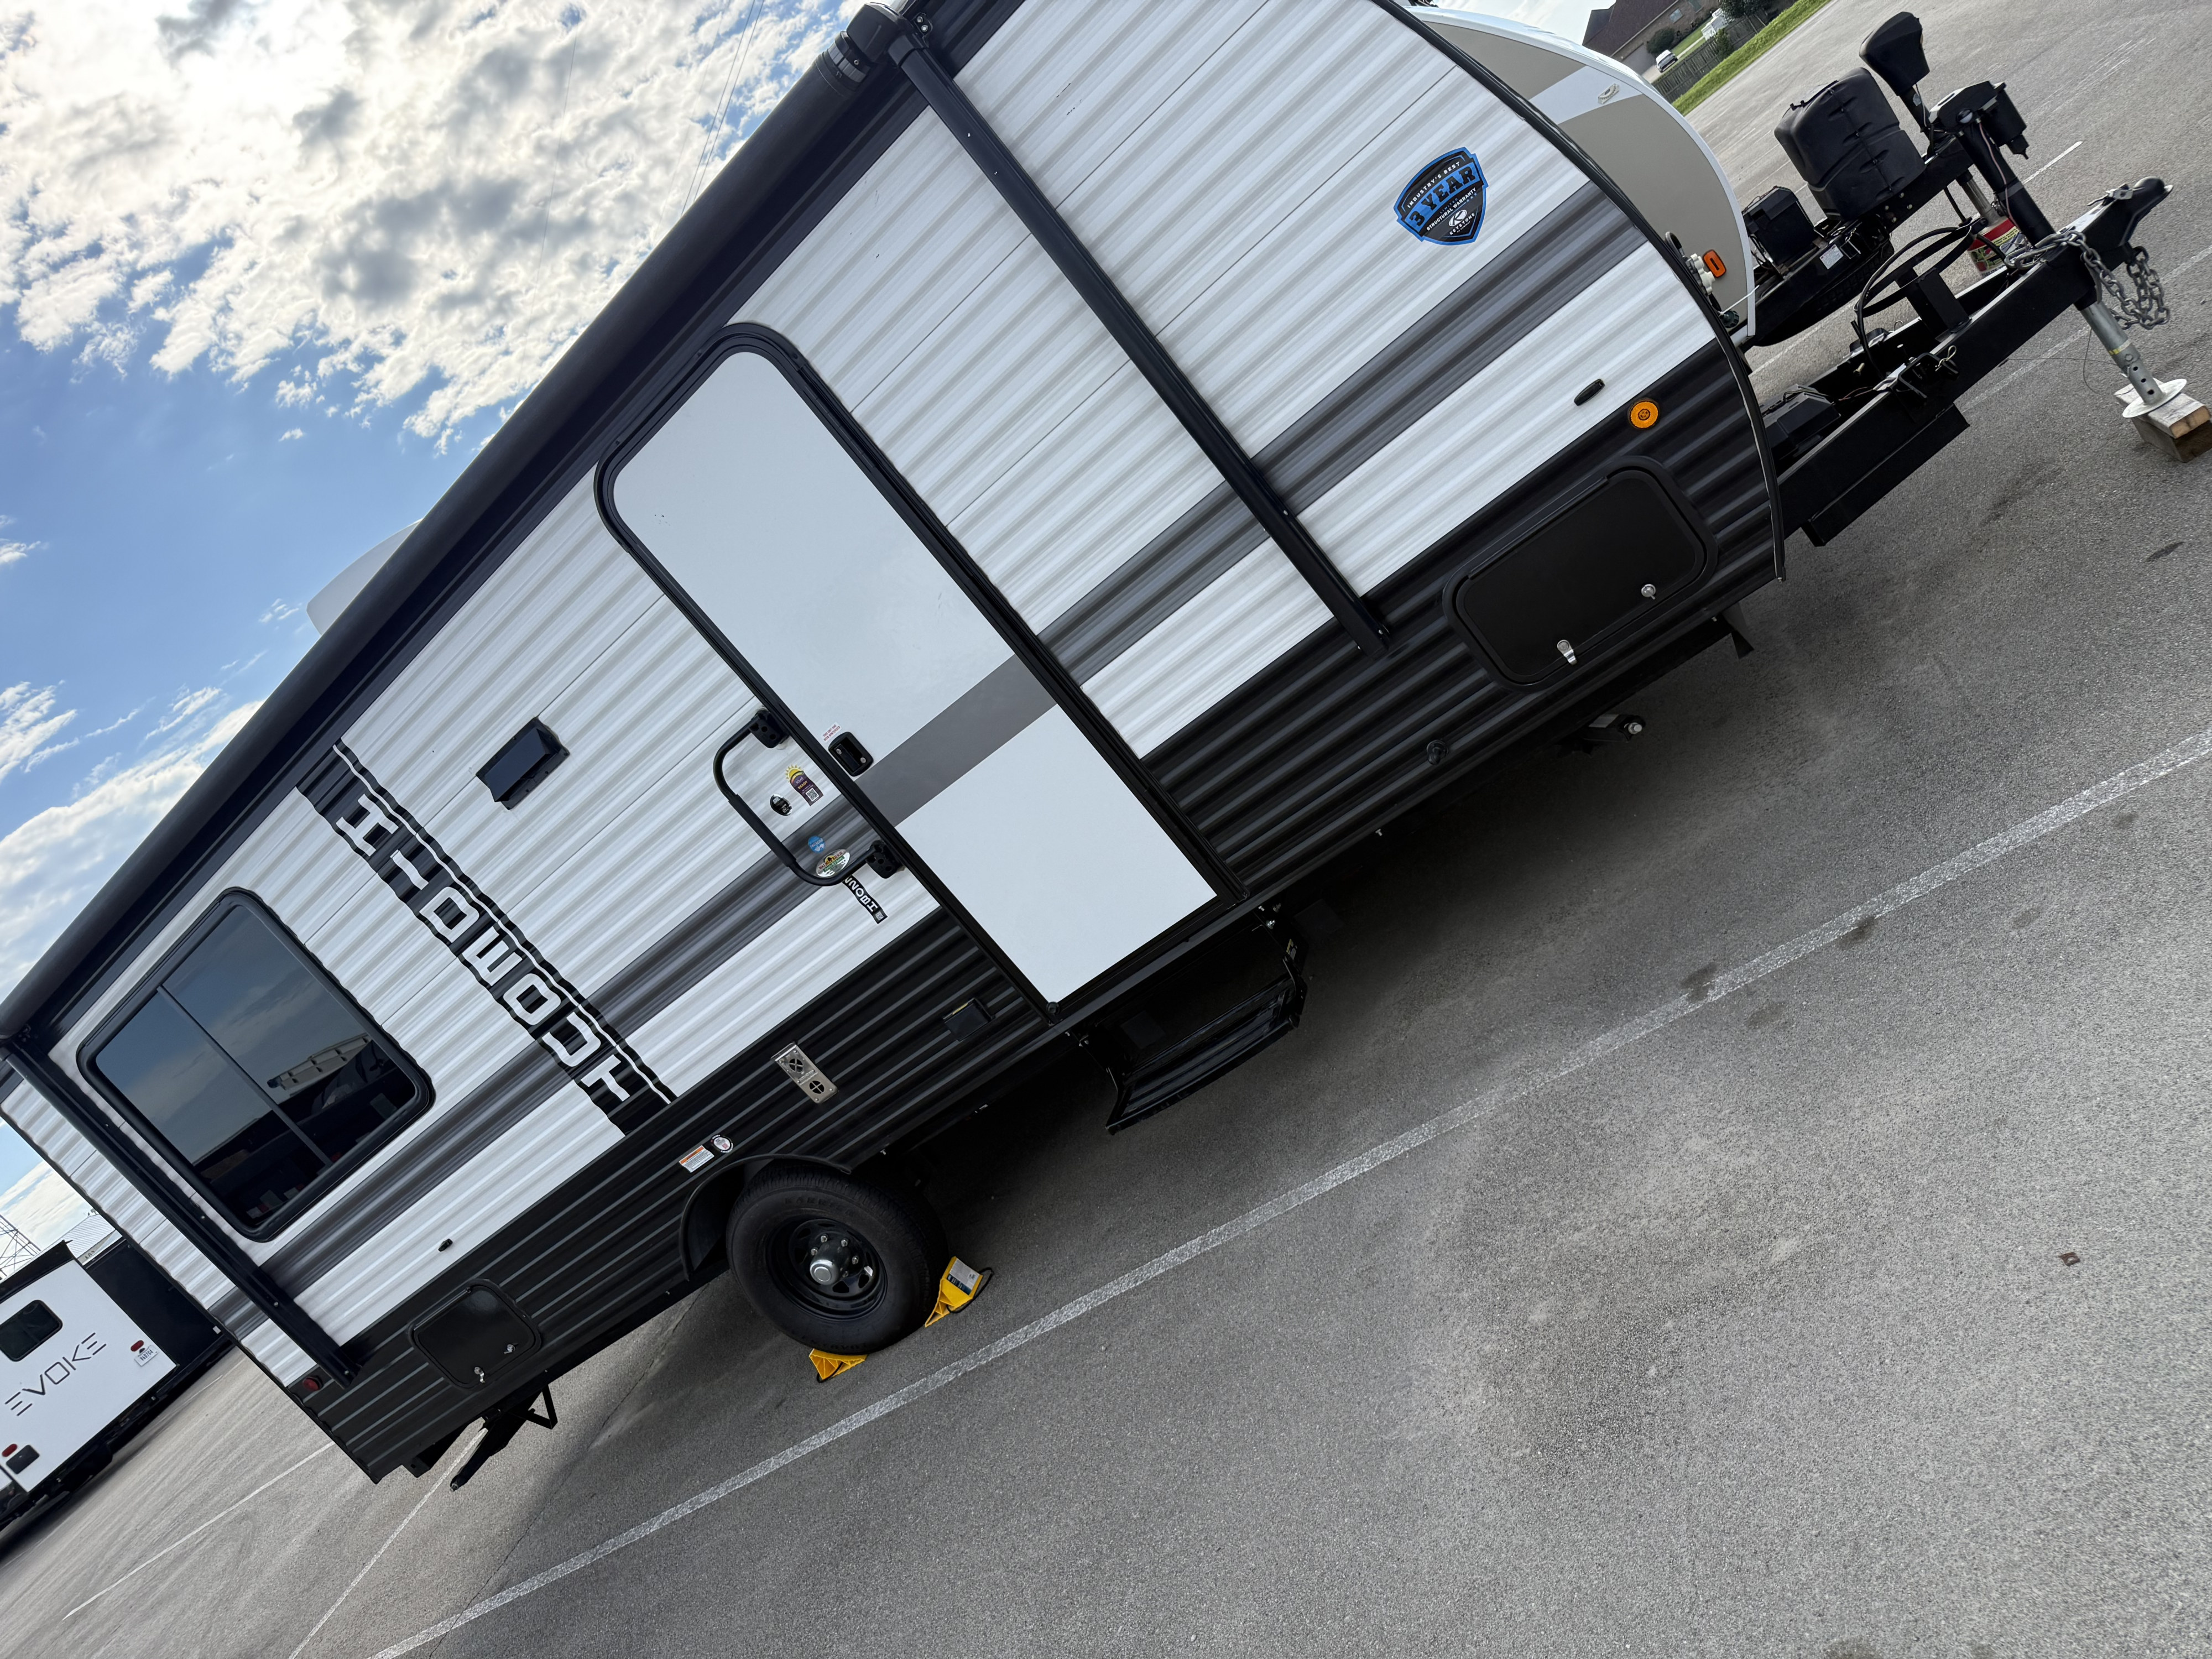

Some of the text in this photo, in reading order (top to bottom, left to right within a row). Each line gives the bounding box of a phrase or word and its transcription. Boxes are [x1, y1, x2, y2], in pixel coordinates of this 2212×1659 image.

[1407, 161, 1460, 208] INDUSTRY'S BEST
[1410, 166, 1476, 226] 3 YEAR
[1426, 207, 1453, 231] STRUCTURAL
[1453, 187, 1477, 208] WARRANTY
[1449, 213, 1475, 235] KEYSTONE
[797, 780, 808, 789] READY
[336, 794, 630, 1102] HIDEOUT
[4, 1332, 107, 1416] EVOKE
